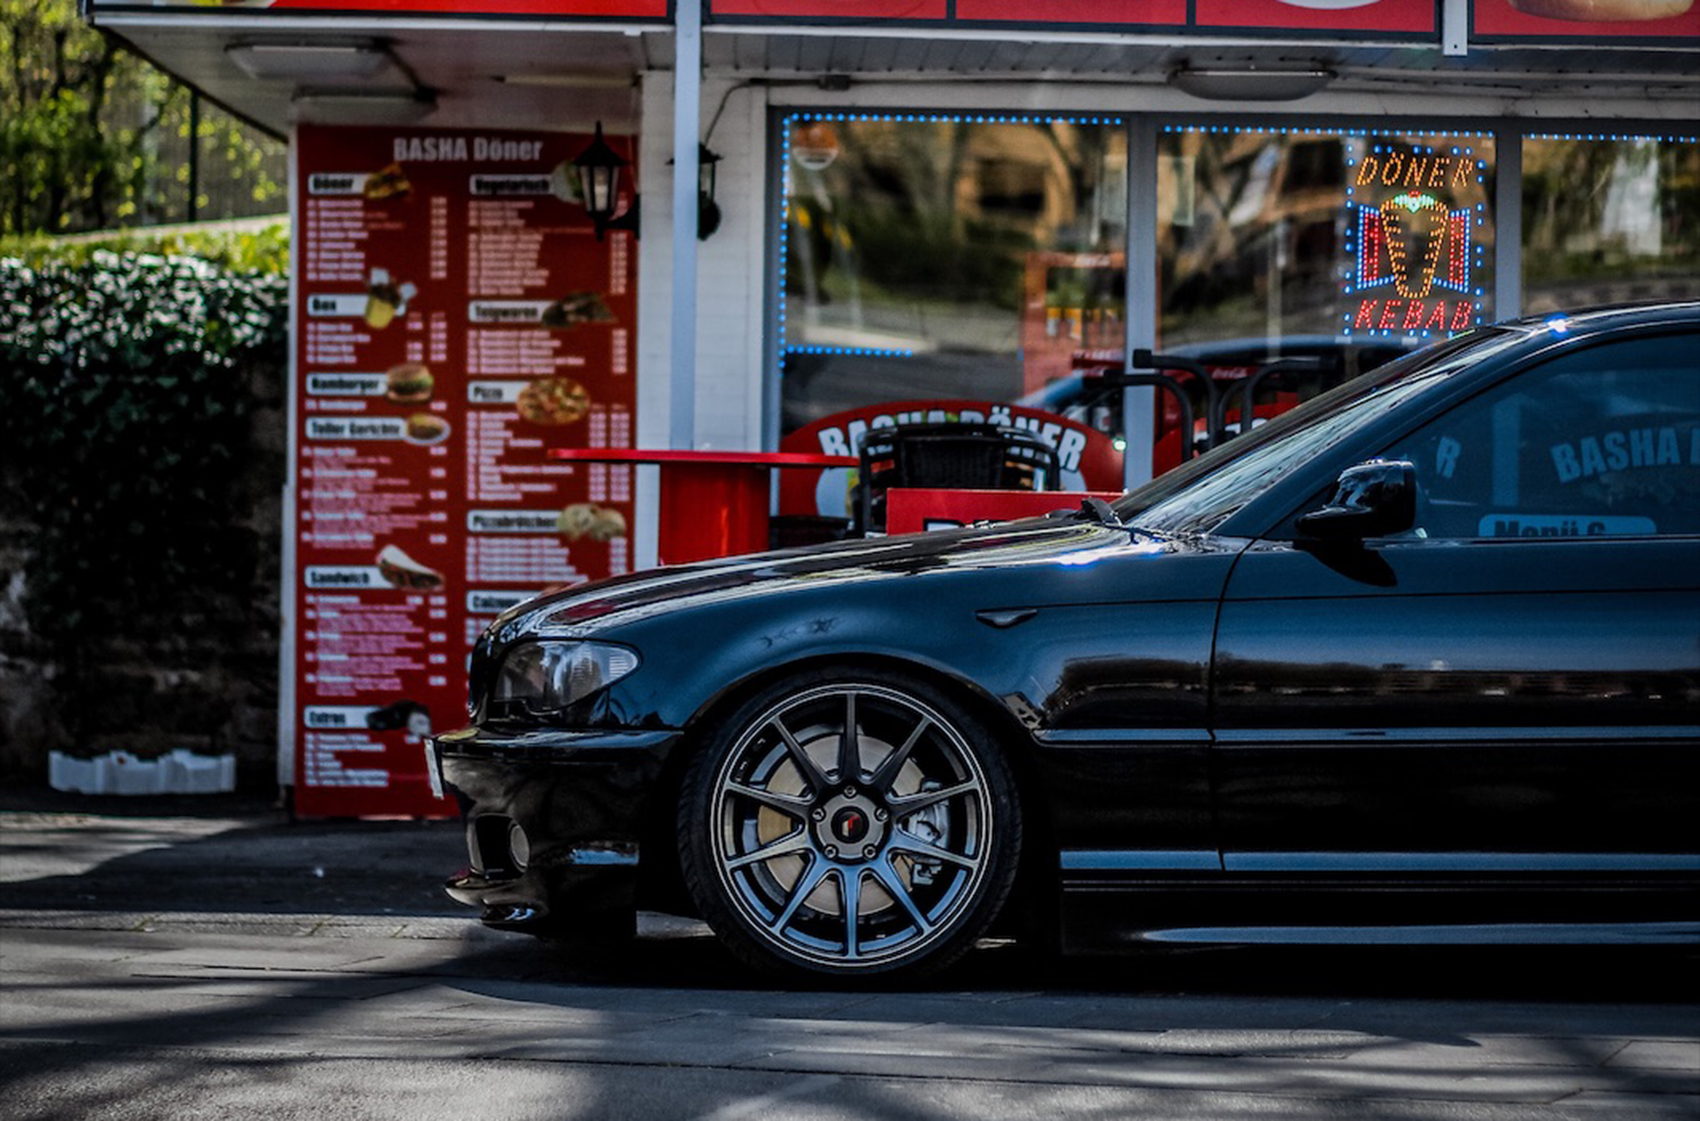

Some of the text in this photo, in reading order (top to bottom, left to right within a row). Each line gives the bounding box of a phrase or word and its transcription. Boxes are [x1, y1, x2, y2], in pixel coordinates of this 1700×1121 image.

[393, 137, 543, 162] BASHA Döner
[1357, 151, 1474, 187] DÖNER
[1355, 299, 1473, 330] KEBAB
[1550, 426, 1681, 484] BASHA
